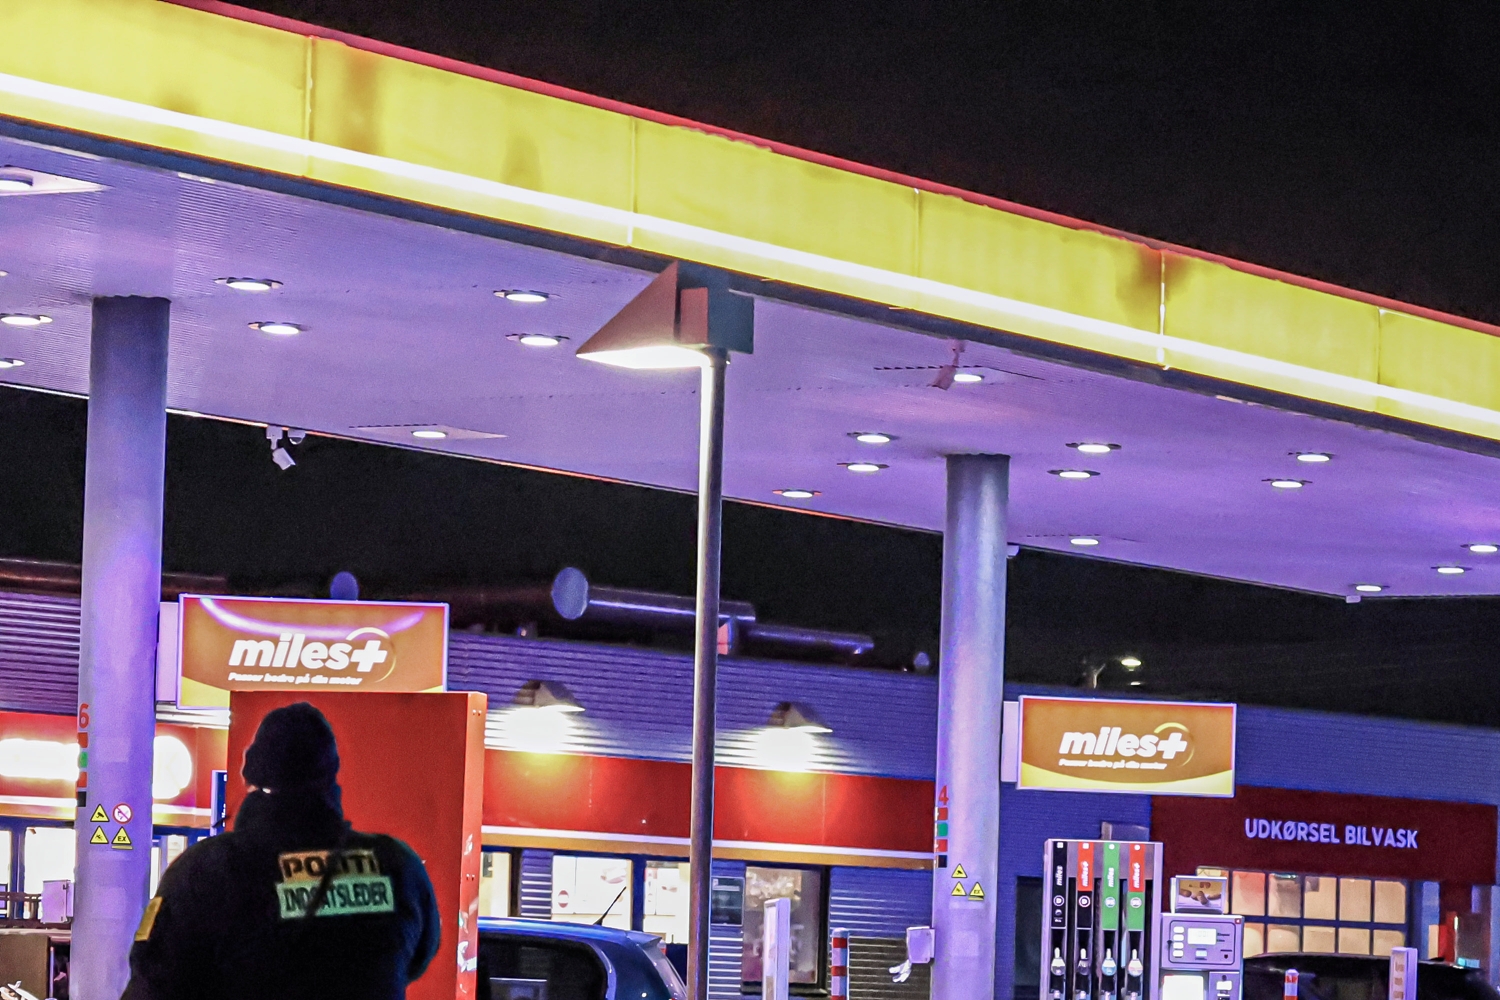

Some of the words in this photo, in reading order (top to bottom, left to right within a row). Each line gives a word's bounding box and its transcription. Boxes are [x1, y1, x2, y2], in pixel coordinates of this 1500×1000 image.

[228, 632, 388, 673] miles+
[78, 702, 90, 729] 6
[938, 784, 949, 806] 4
[1244, 818, 1340, 844] UDKØRSEL
[1344, 824, 1418, 849] BILVASK
[282, 854, 378, 878] POITI
